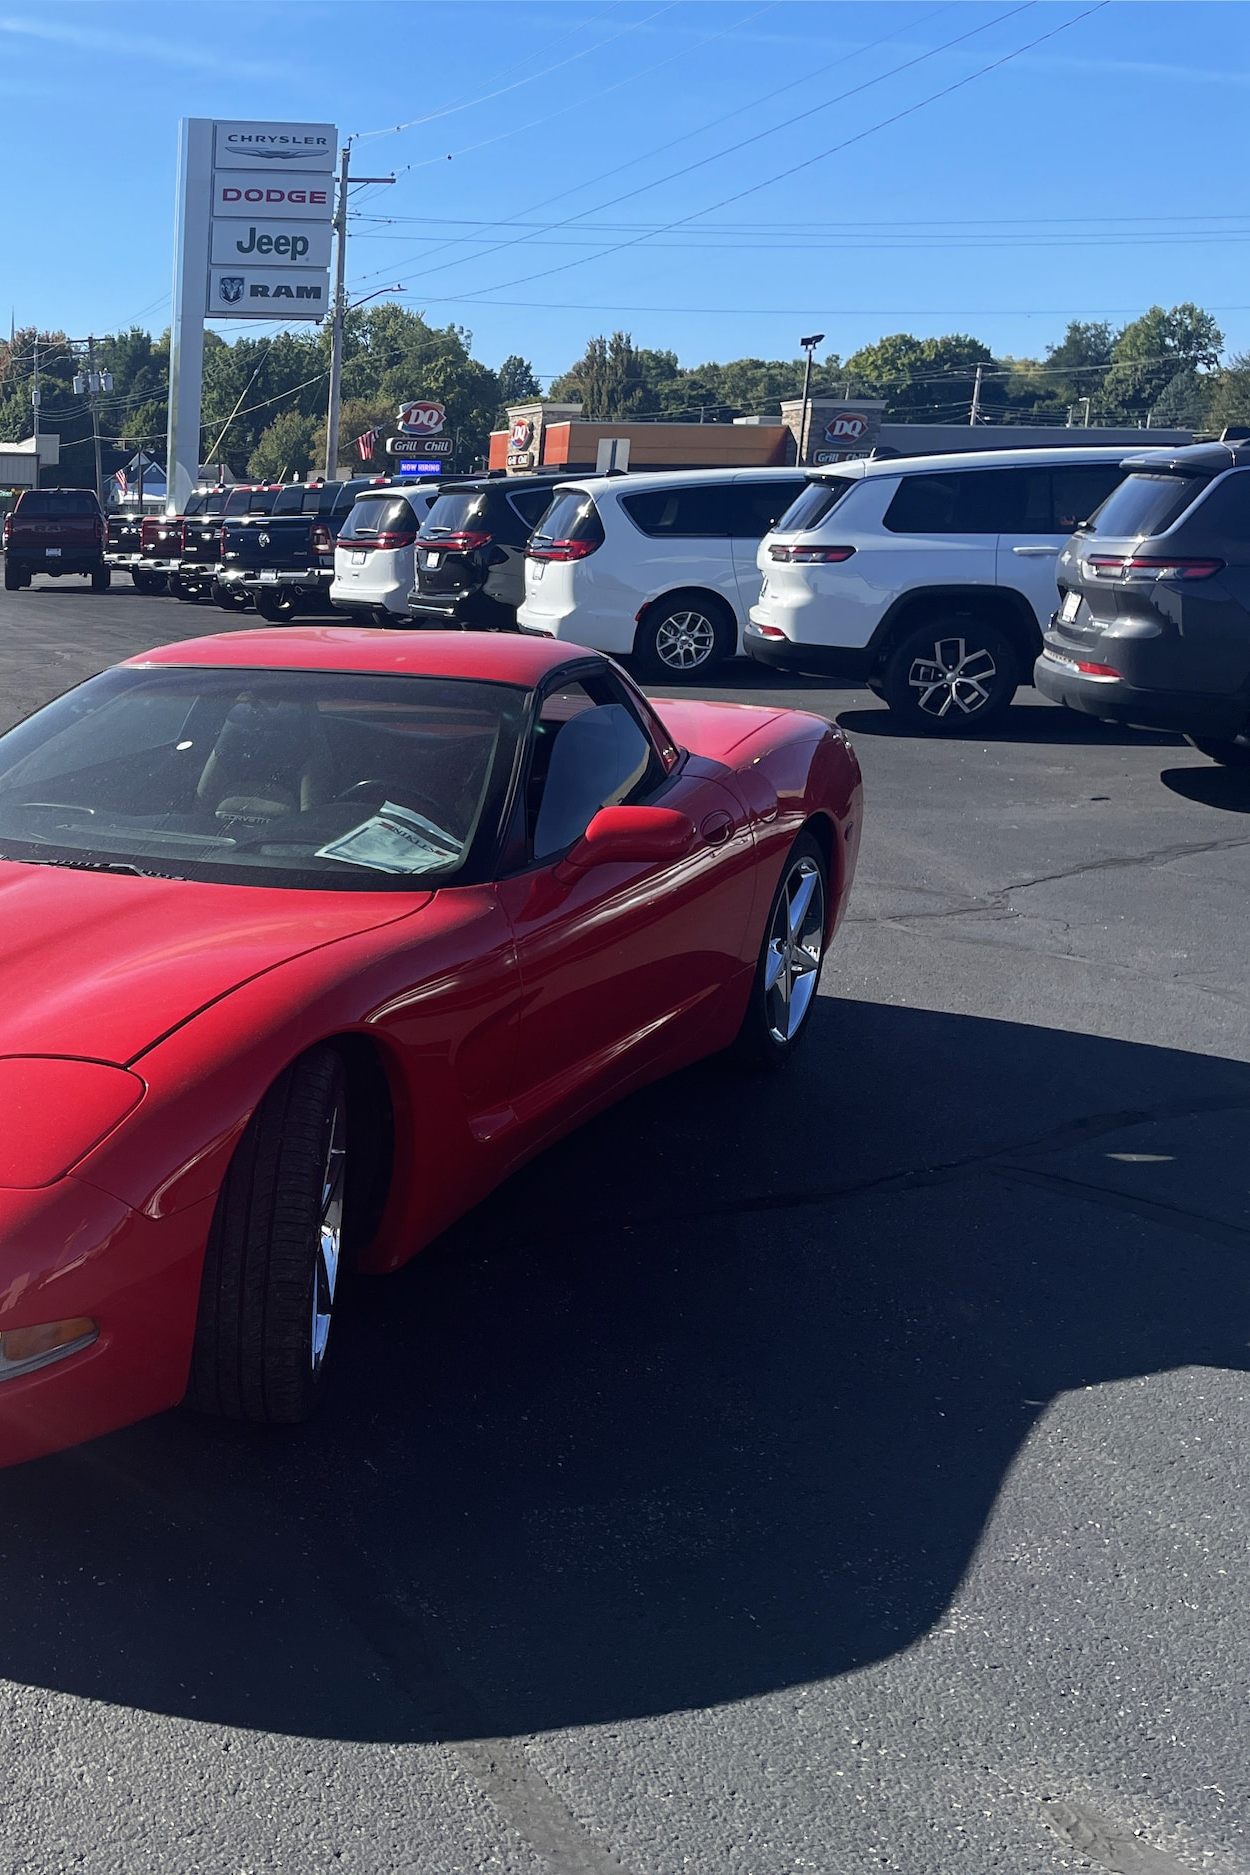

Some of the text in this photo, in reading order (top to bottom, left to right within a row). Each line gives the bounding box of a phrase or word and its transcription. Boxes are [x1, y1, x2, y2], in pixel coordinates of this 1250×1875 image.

[228, 134, 327, 146] CHRYSLER
[222, 188, 327, 204] DODGE
[236, 227, 309, 261] Jeep
[249, 284, 322, 300] RAM
[408, 409, 440, 427] DQ
[513, 425, 526, 441] DQ
[833, 420, 863, 437] DQ
[394, 441, 449, 451] Grill Chill
[817, 453, 839, 463] Grill
[401, 463, 440, 472] NOW HIRING
